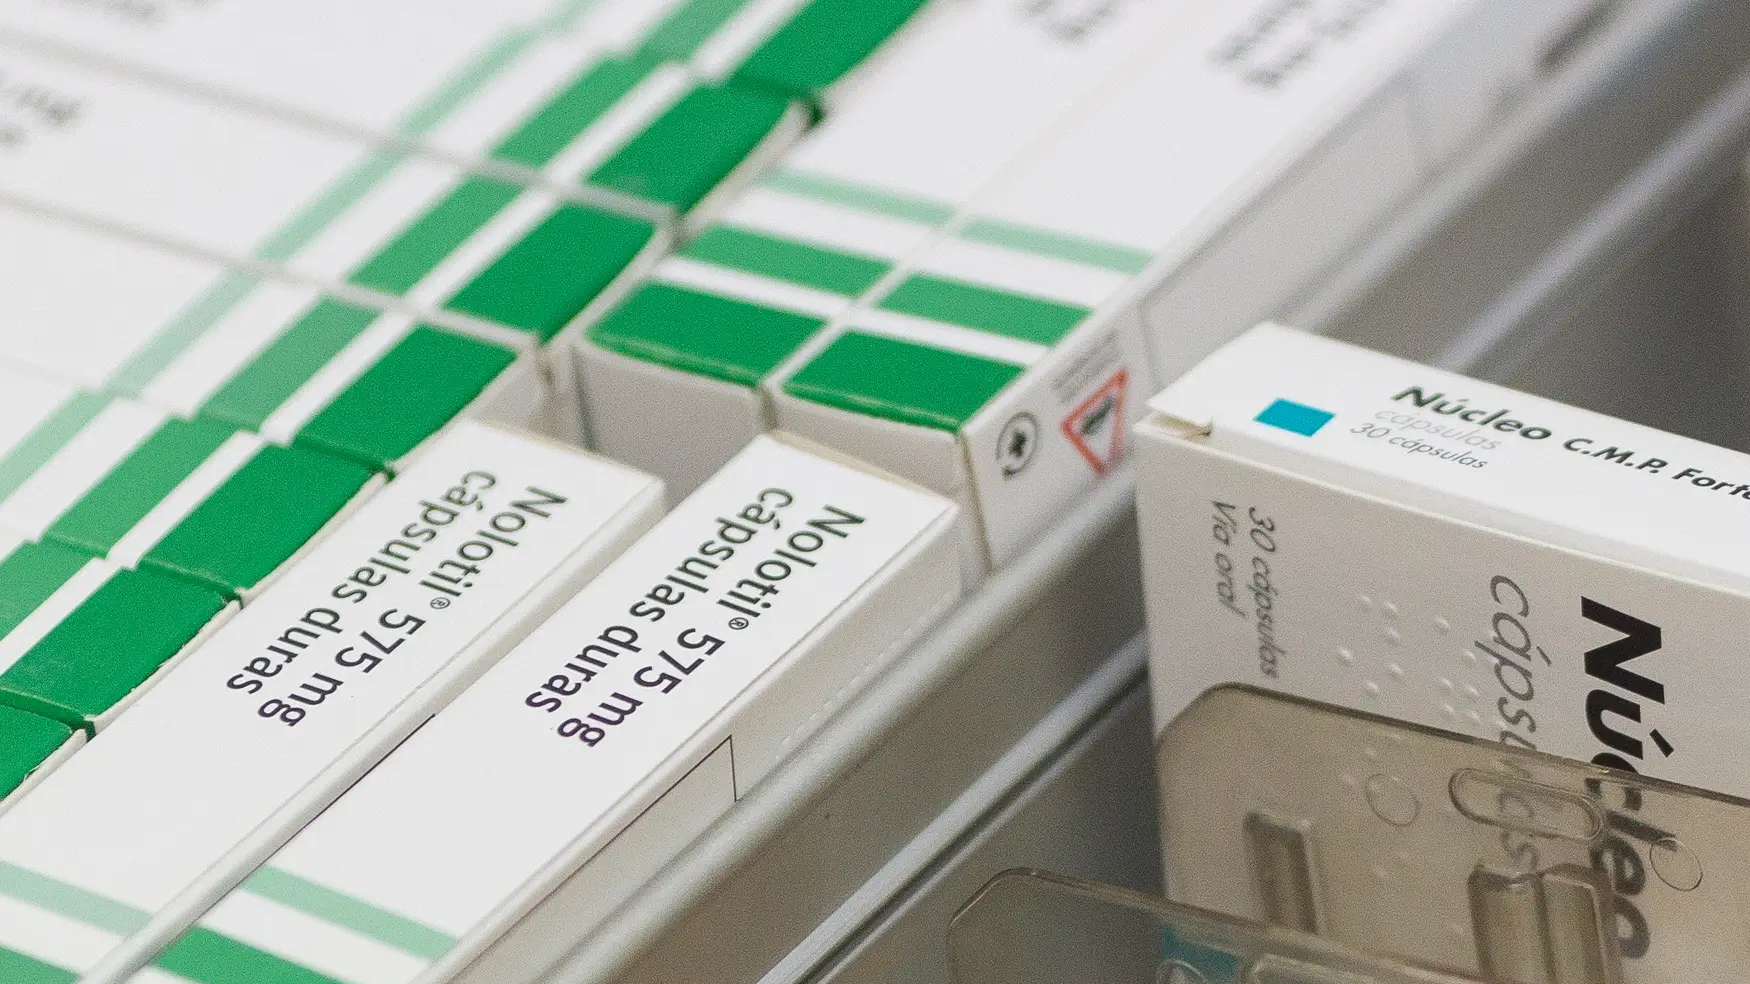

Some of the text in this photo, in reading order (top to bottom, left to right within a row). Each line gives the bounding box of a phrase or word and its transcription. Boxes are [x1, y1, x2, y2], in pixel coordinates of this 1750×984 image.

[1351, 421, 1489, 471] 30 cápsulas
[1373, 404, 1501, 452] cápsulas
[1390, 386, 1552, 443] Núcleo
[1563, 434, 1667, 476] C.M.P.
[1246, 507, 1278, 551] 30
[226, 470, 496, 694] cápsulas duras
[257, 486, 569, 727] Nolotil® 575 mg
[525, 487, 794, 713] cápsulas duras
[556, 504, 865, 747] Nolotil® 575 mg
[1213, 553, 1247, 618] oral
